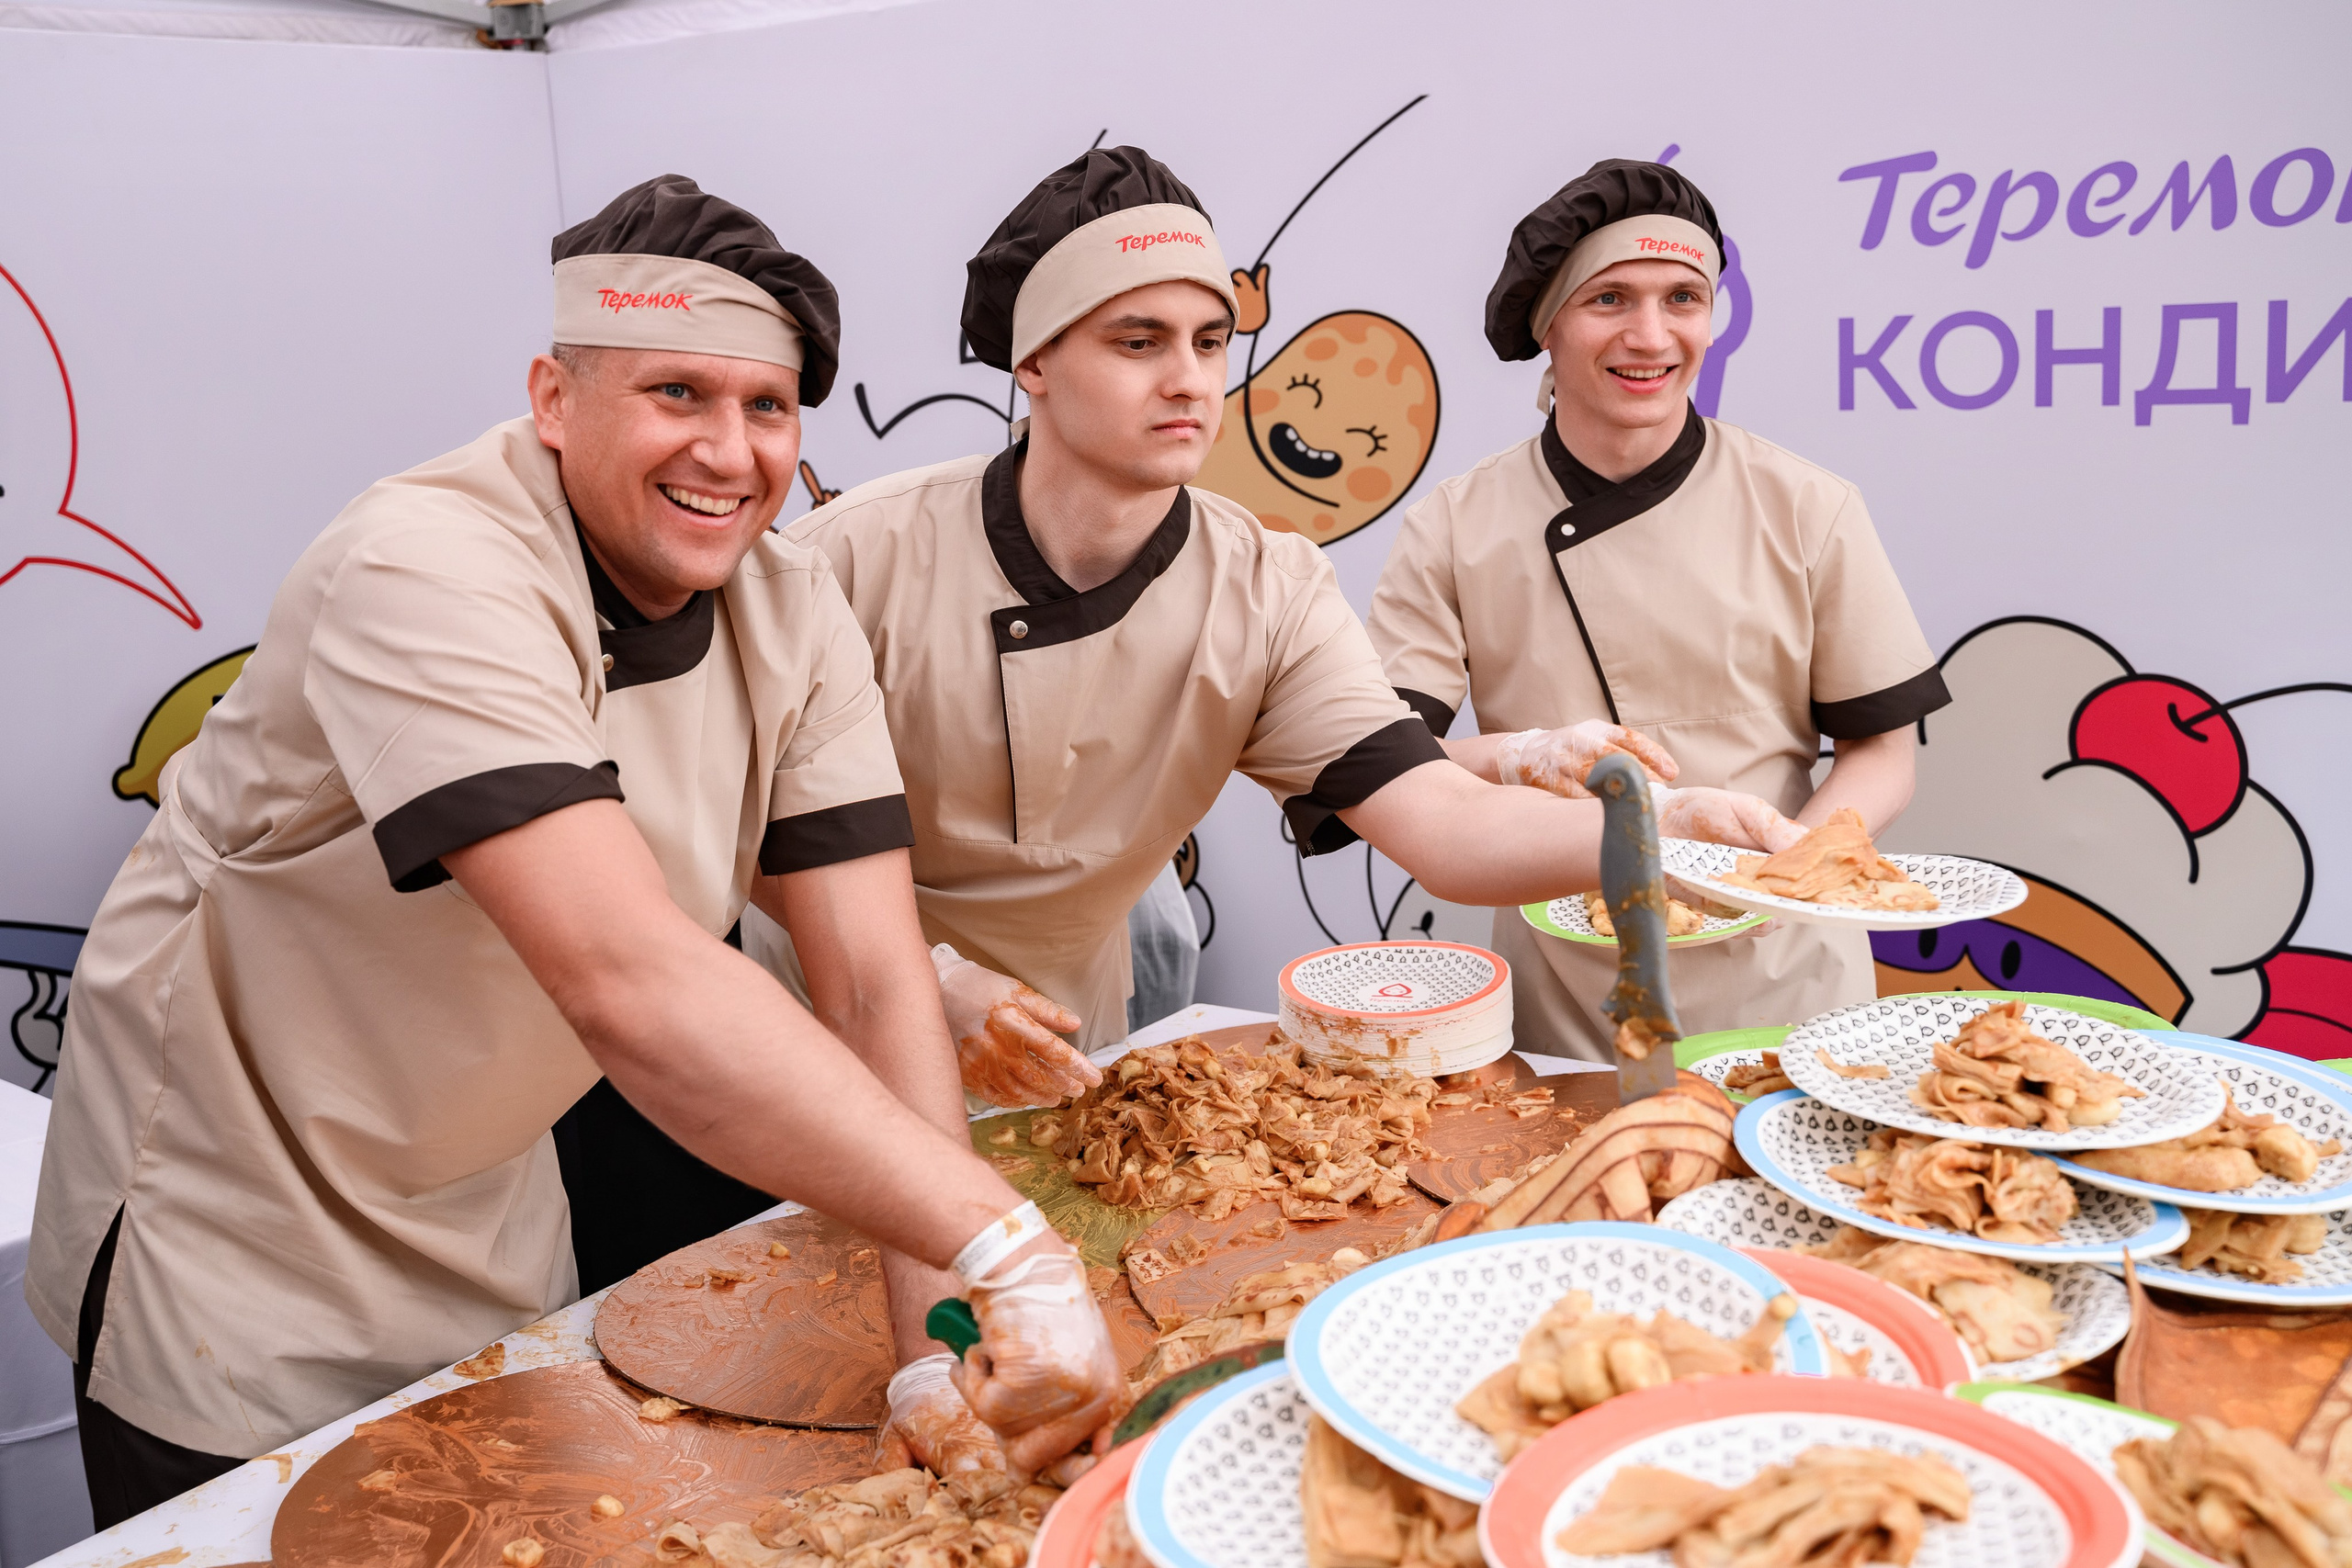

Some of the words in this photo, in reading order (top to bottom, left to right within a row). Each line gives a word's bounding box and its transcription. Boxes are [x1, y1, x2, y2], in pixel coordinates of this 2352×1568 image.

[1838, 147, 2352, 269] Теремо
[1114, 231, 1206, 253] Теремок
[1634, 237, 1705, 265] Теремок
[598, 288, 694, 314] Теремок
[1838, 296, 2352, 426] КОНДИ
